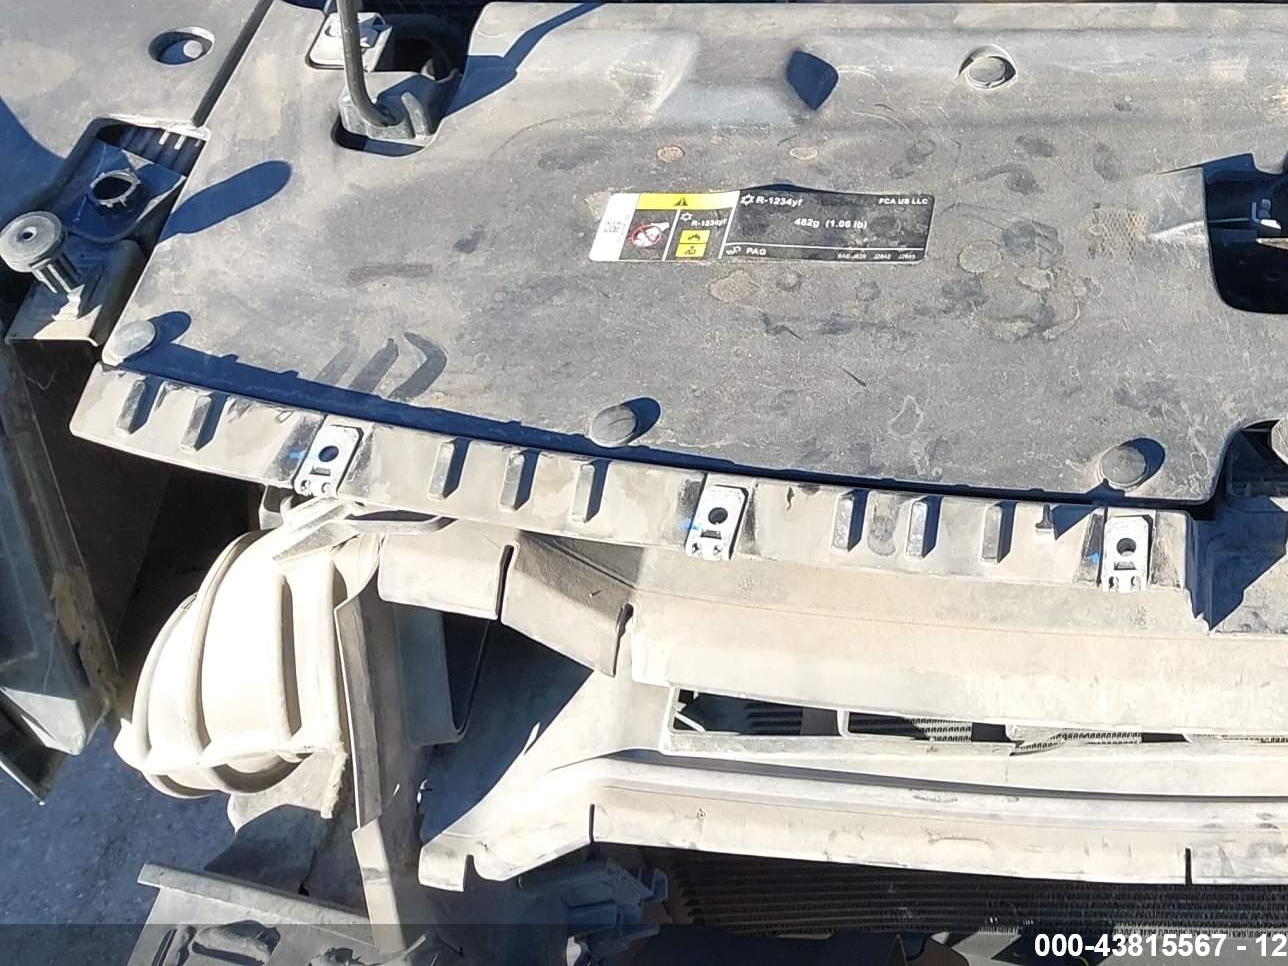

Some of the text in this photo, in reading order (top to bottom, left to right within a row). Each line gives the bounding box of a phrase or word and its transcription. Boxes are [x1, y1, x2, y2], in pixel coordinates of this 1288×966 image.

[755, 195, 803, 207] R-1234yf
[879, 198, 928, 206] FCA US LLC
